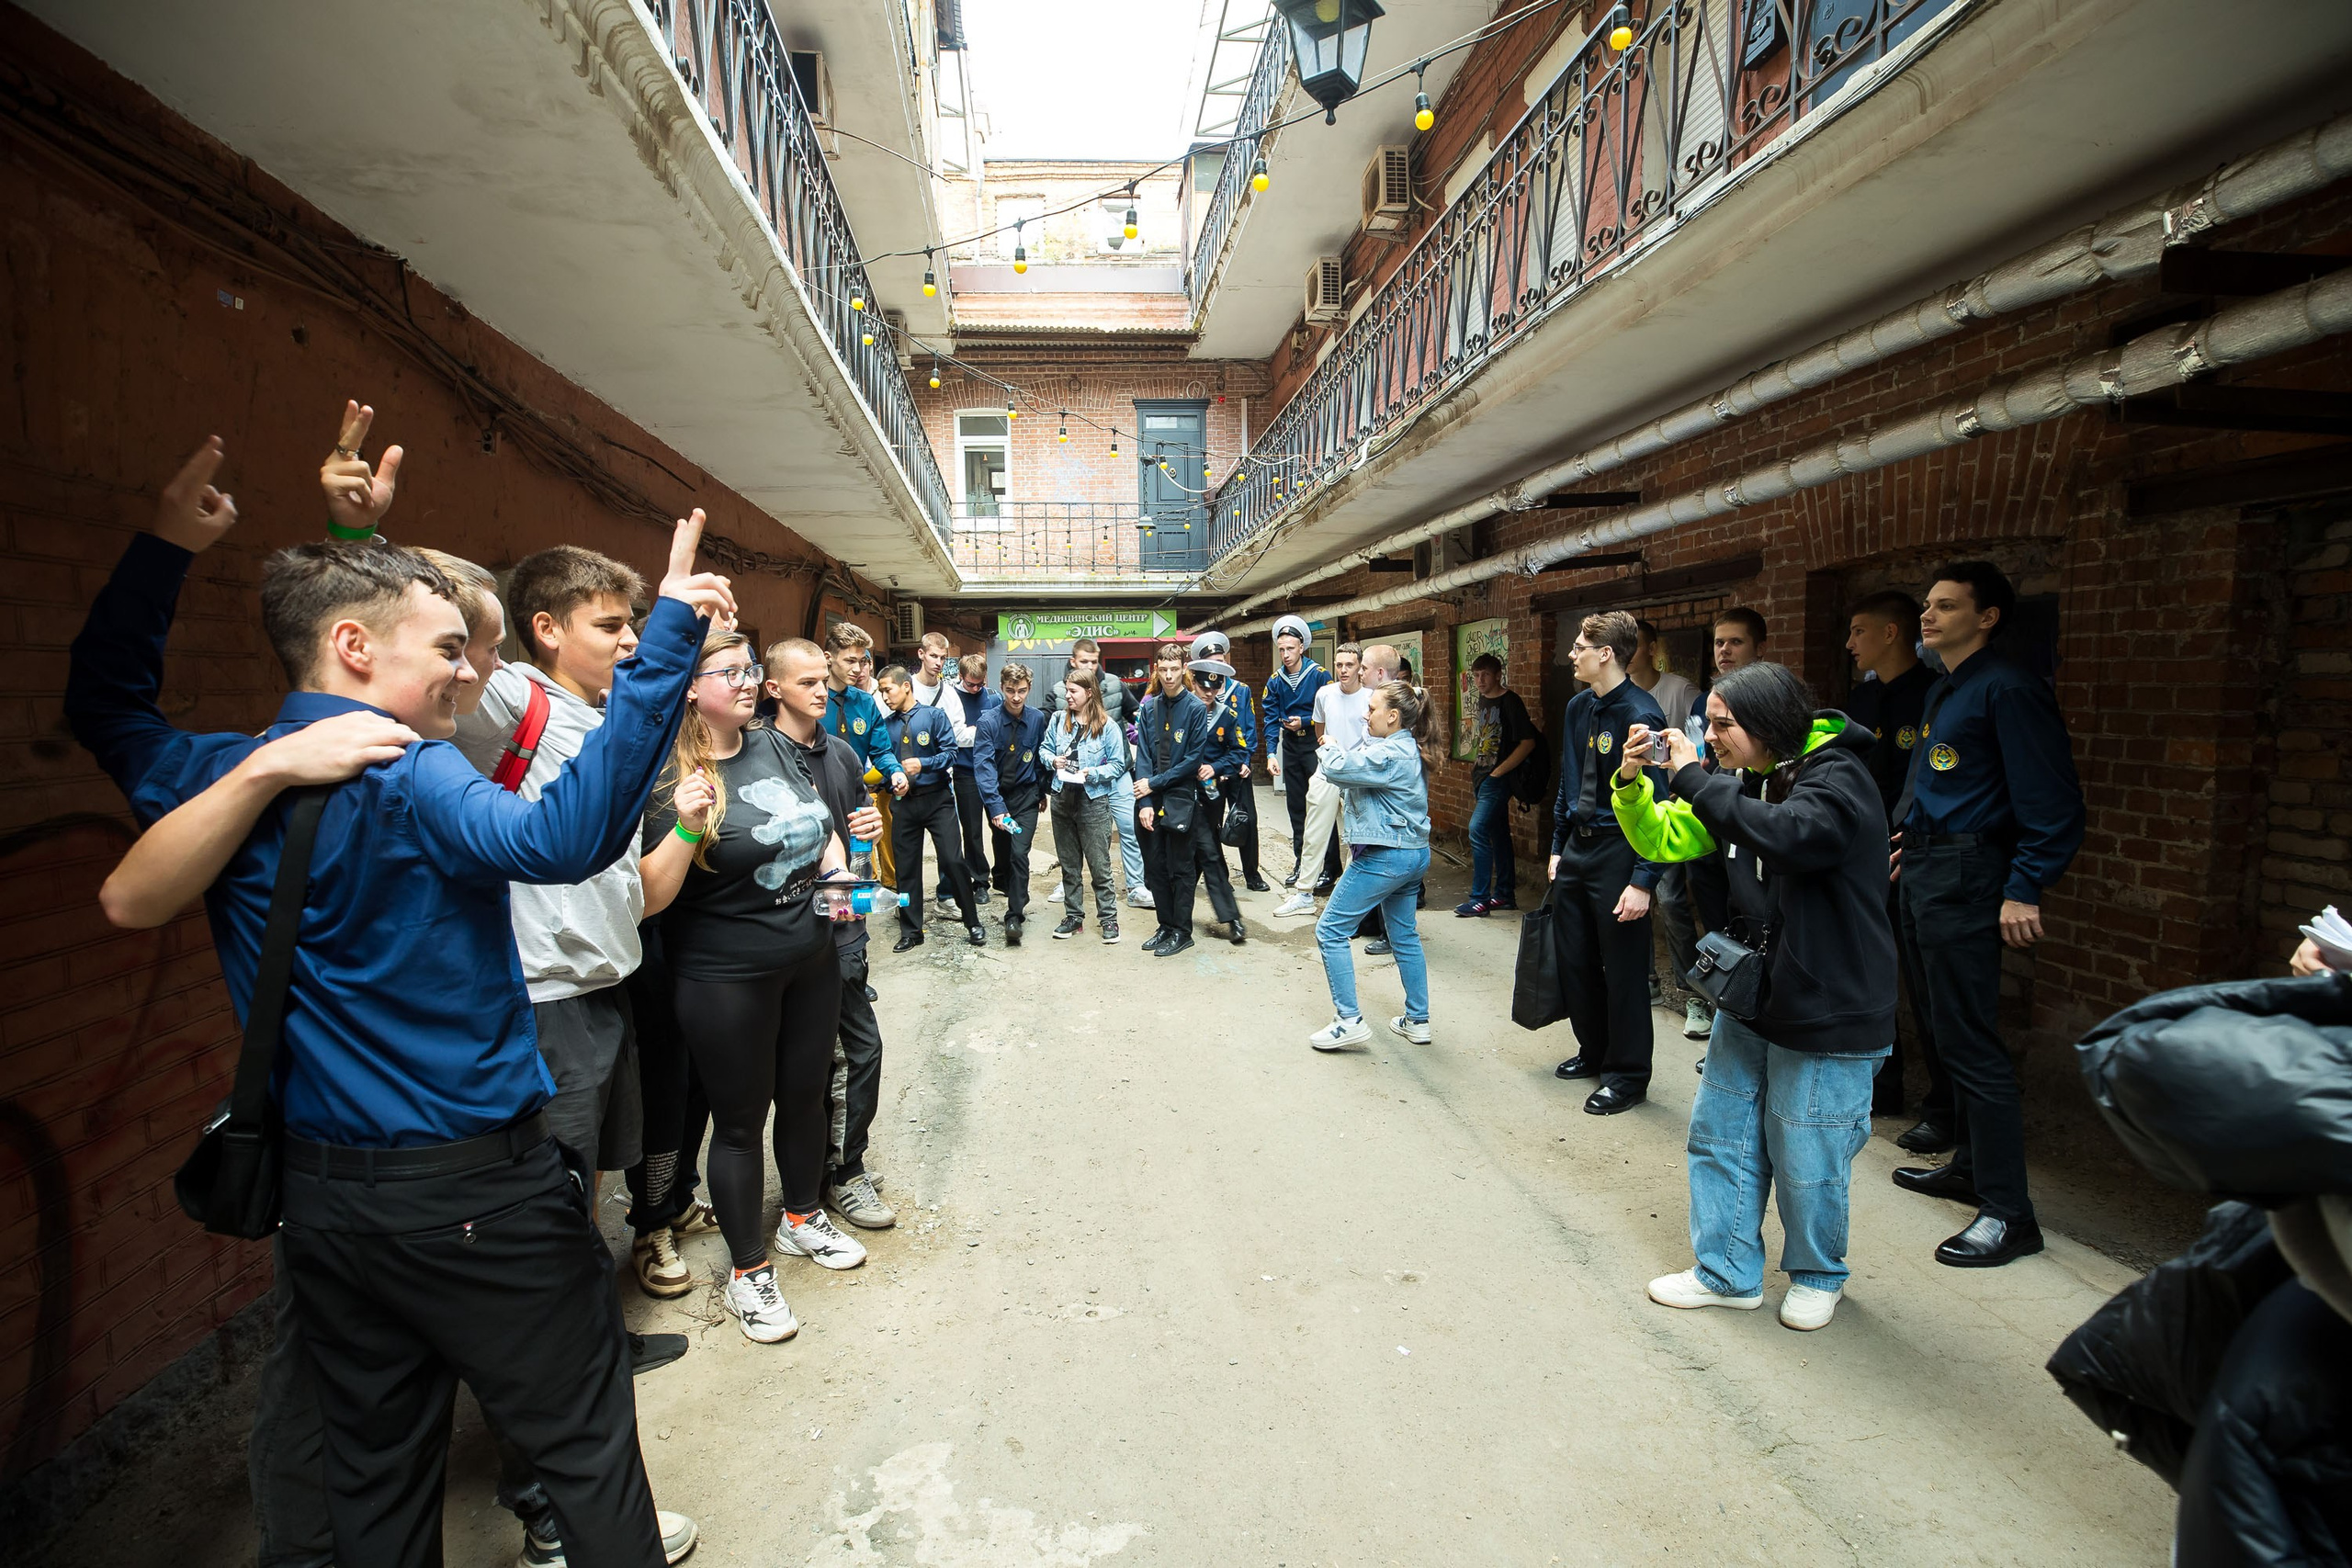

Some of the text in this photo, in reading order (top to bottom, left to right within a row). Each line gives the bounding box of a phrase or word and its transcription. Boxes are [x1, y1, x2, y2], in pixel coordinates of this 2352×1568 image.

[1036, 614, 1148, 624] МЕДИЦИНСКИЙ ЦЕНТР
[1066, 626, 1119, 637] «ЭДИС»
